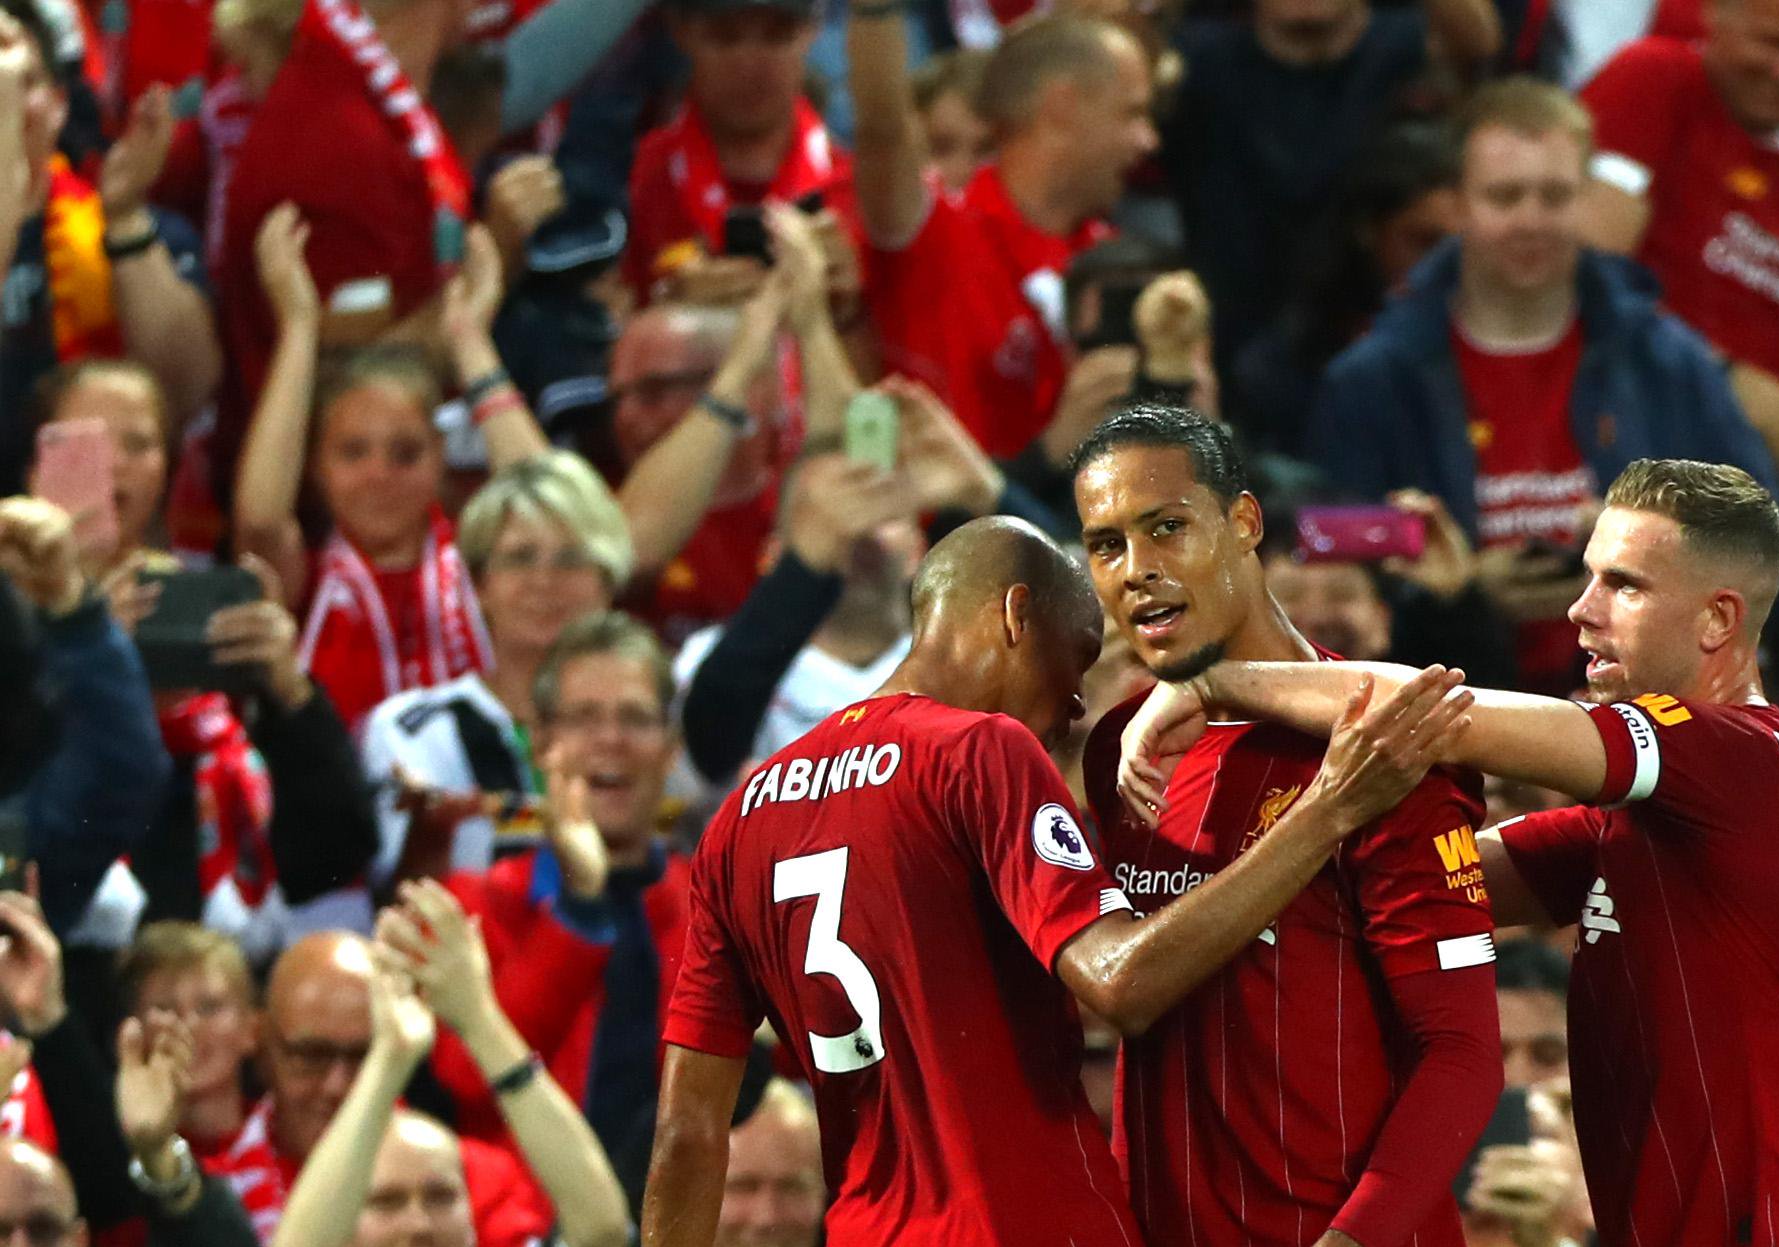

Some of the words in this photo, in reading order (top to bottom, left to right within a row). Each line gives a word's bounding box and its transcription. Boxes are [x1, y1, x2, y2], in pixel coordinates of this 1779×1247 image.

[740, 742, 901, 818] FABINHO
[1114, 862, 1215, 896] Standar
[772, 845, 886, 1074] 3
